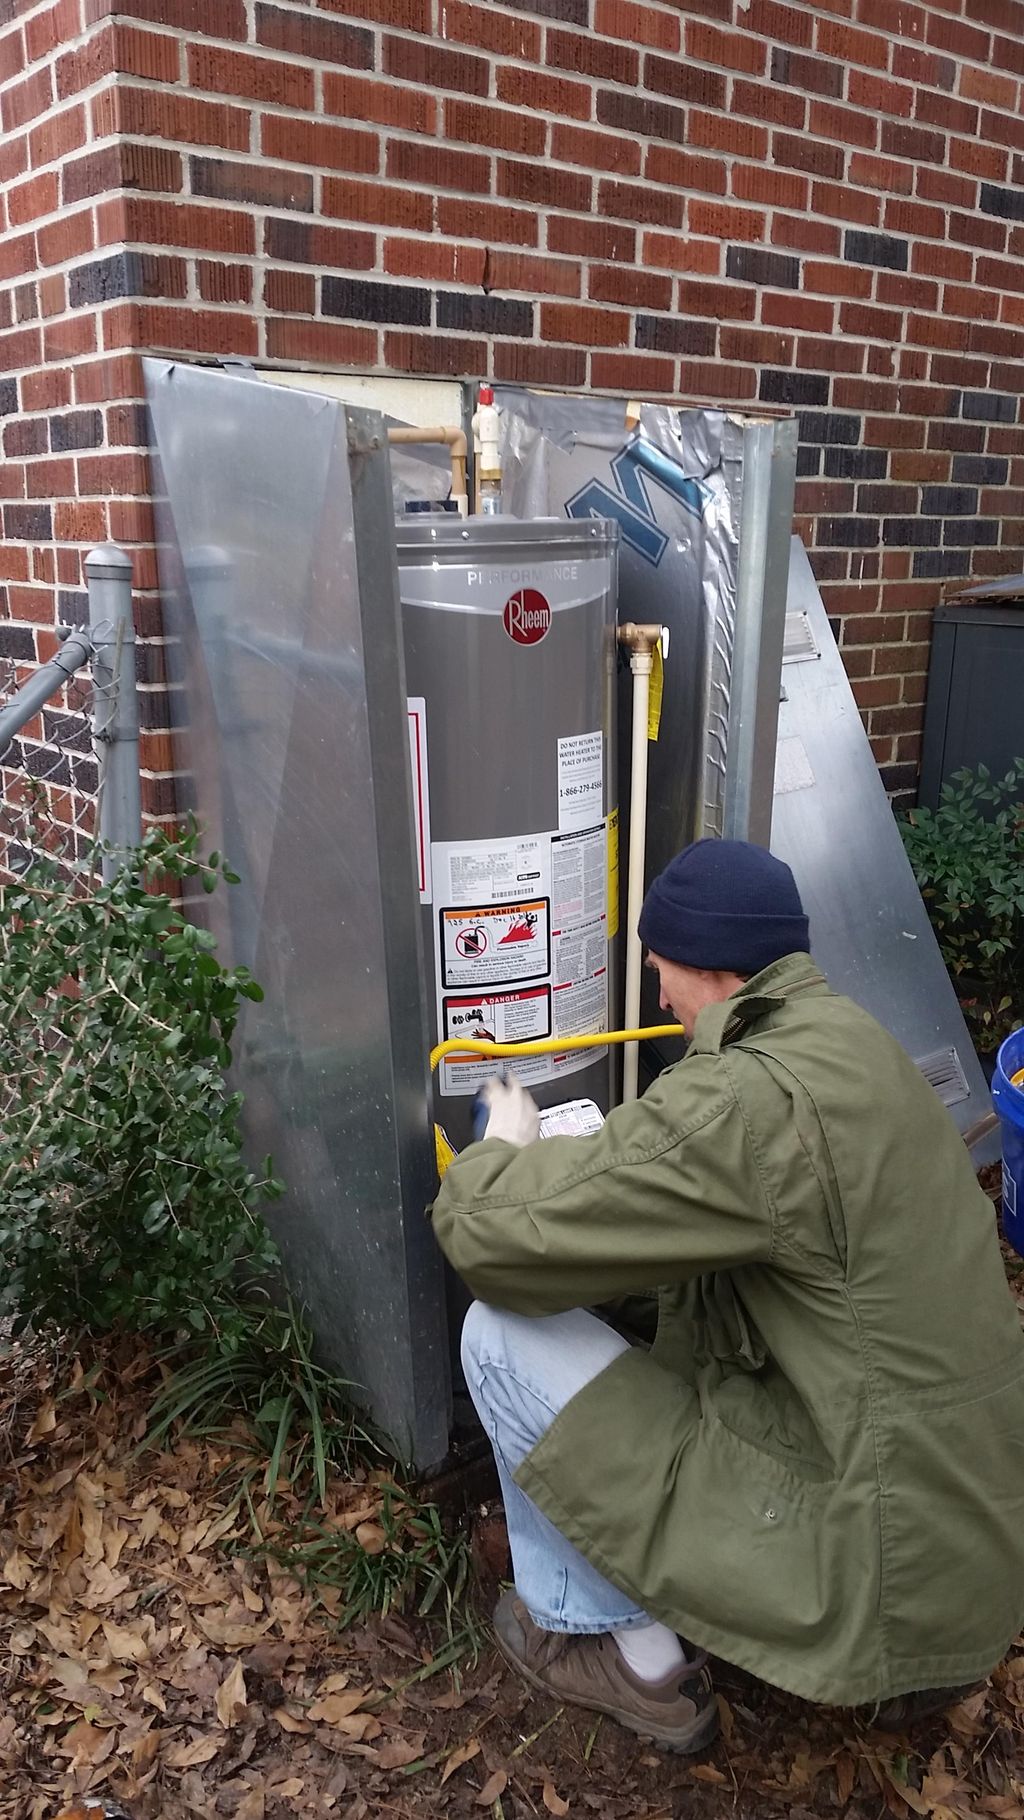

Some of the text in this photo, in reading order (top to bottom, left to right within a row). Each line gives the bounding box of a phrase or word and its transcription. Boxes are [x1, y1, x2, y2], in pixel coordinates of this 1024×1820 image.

[508, 589, 549, 637] Rheem
[560, 742, 568, 750] DO
[561, 759, 575, 767] PLACE
[484, 906, 521, 917] WARNING
[489, 994, 520, 1005] DANGER
